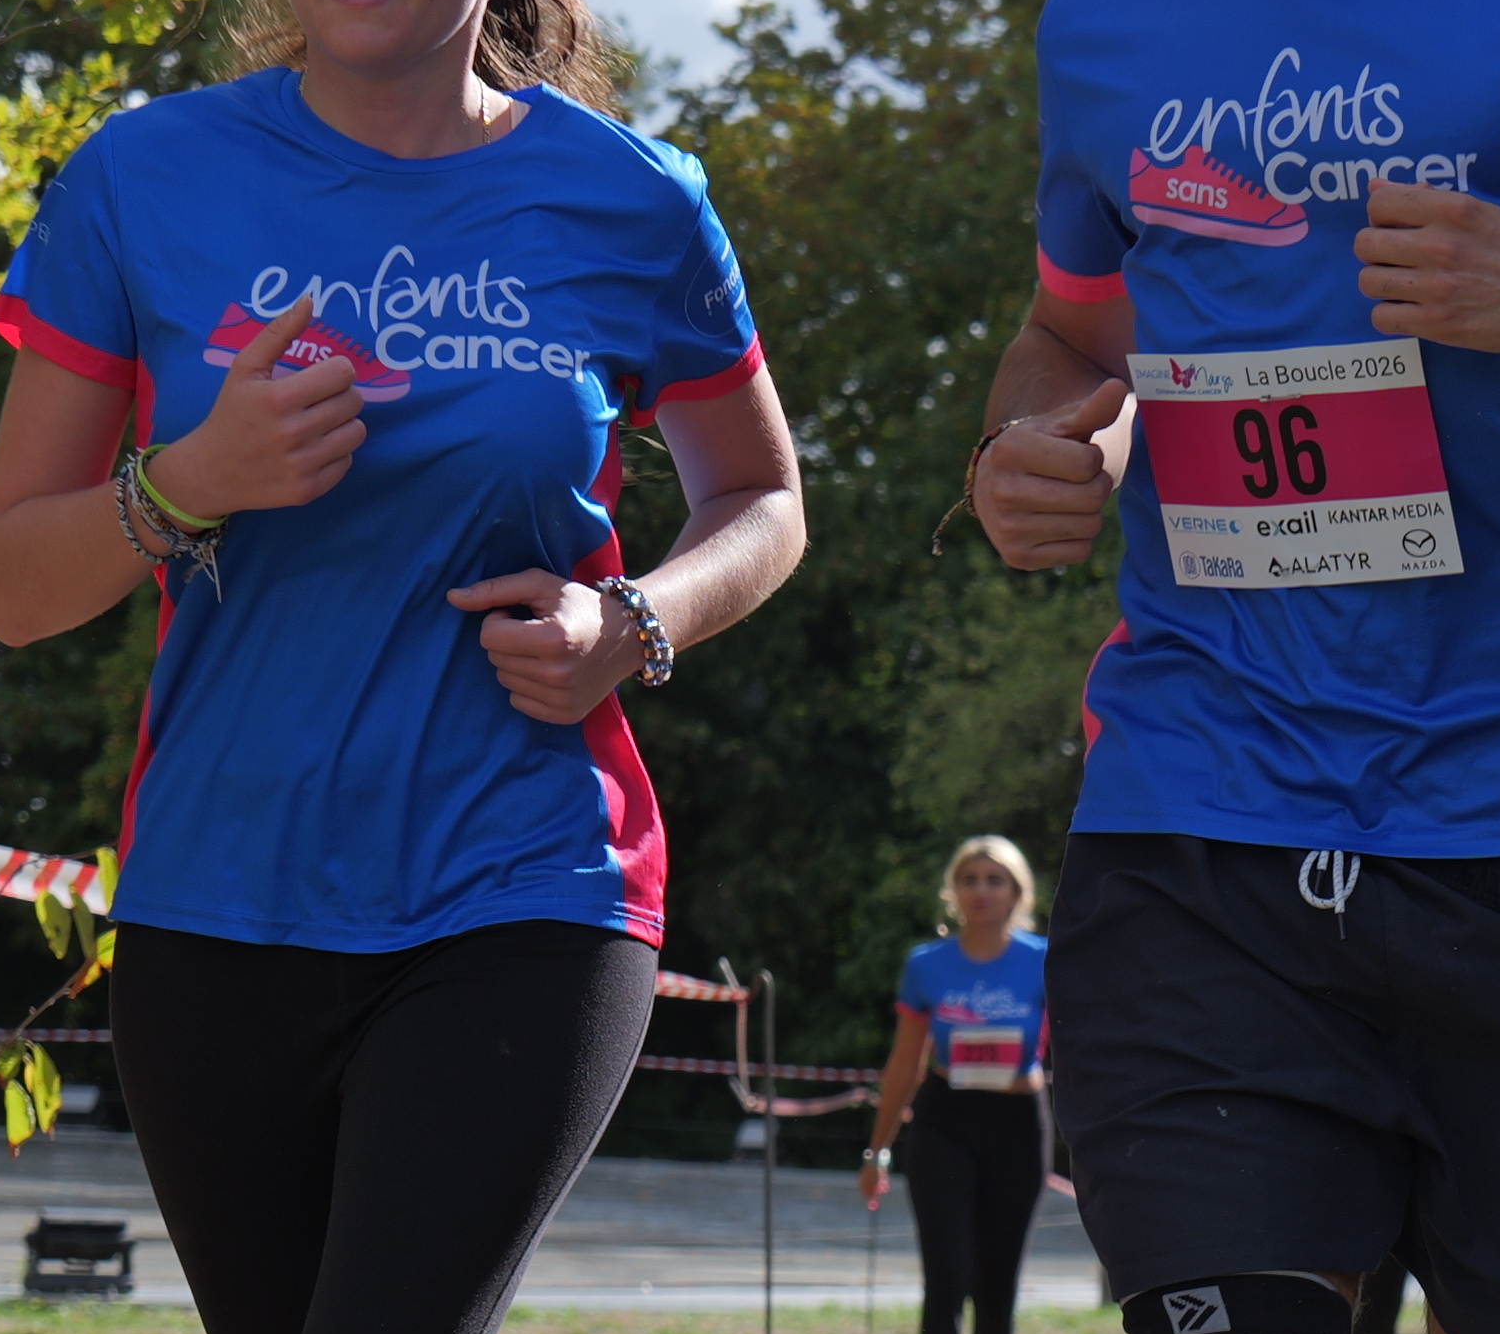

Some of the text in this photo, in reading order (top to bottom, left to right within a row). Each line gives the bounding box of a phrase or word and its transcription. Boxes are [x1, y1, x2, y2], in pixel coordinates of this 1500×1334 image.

[1142, 47, 1404, 166] enfants
[1165, 176, 1229, 209] sans
[1264, 151, 1477, 205] Cancer
[240, 245, 530, 334] enfants
[284, 339, 333, 363] ans
[375, 323, 590, 383] Cancer
[1245, 355, 1406, 387] La Boucle 2026
[1233, 405, 1327, 499] 96
[1168, 516, 1228, 531] VERNE
[1257, 510, 1318, 537] exail
[1328, 502, 1445, 525] KANTAR MEDIA
[1199, 555, 1245, 578] TaKaRa
[1291, 552, 1372, 576] ALATYR
[1402, 559, 1446, 572] MAZDA
